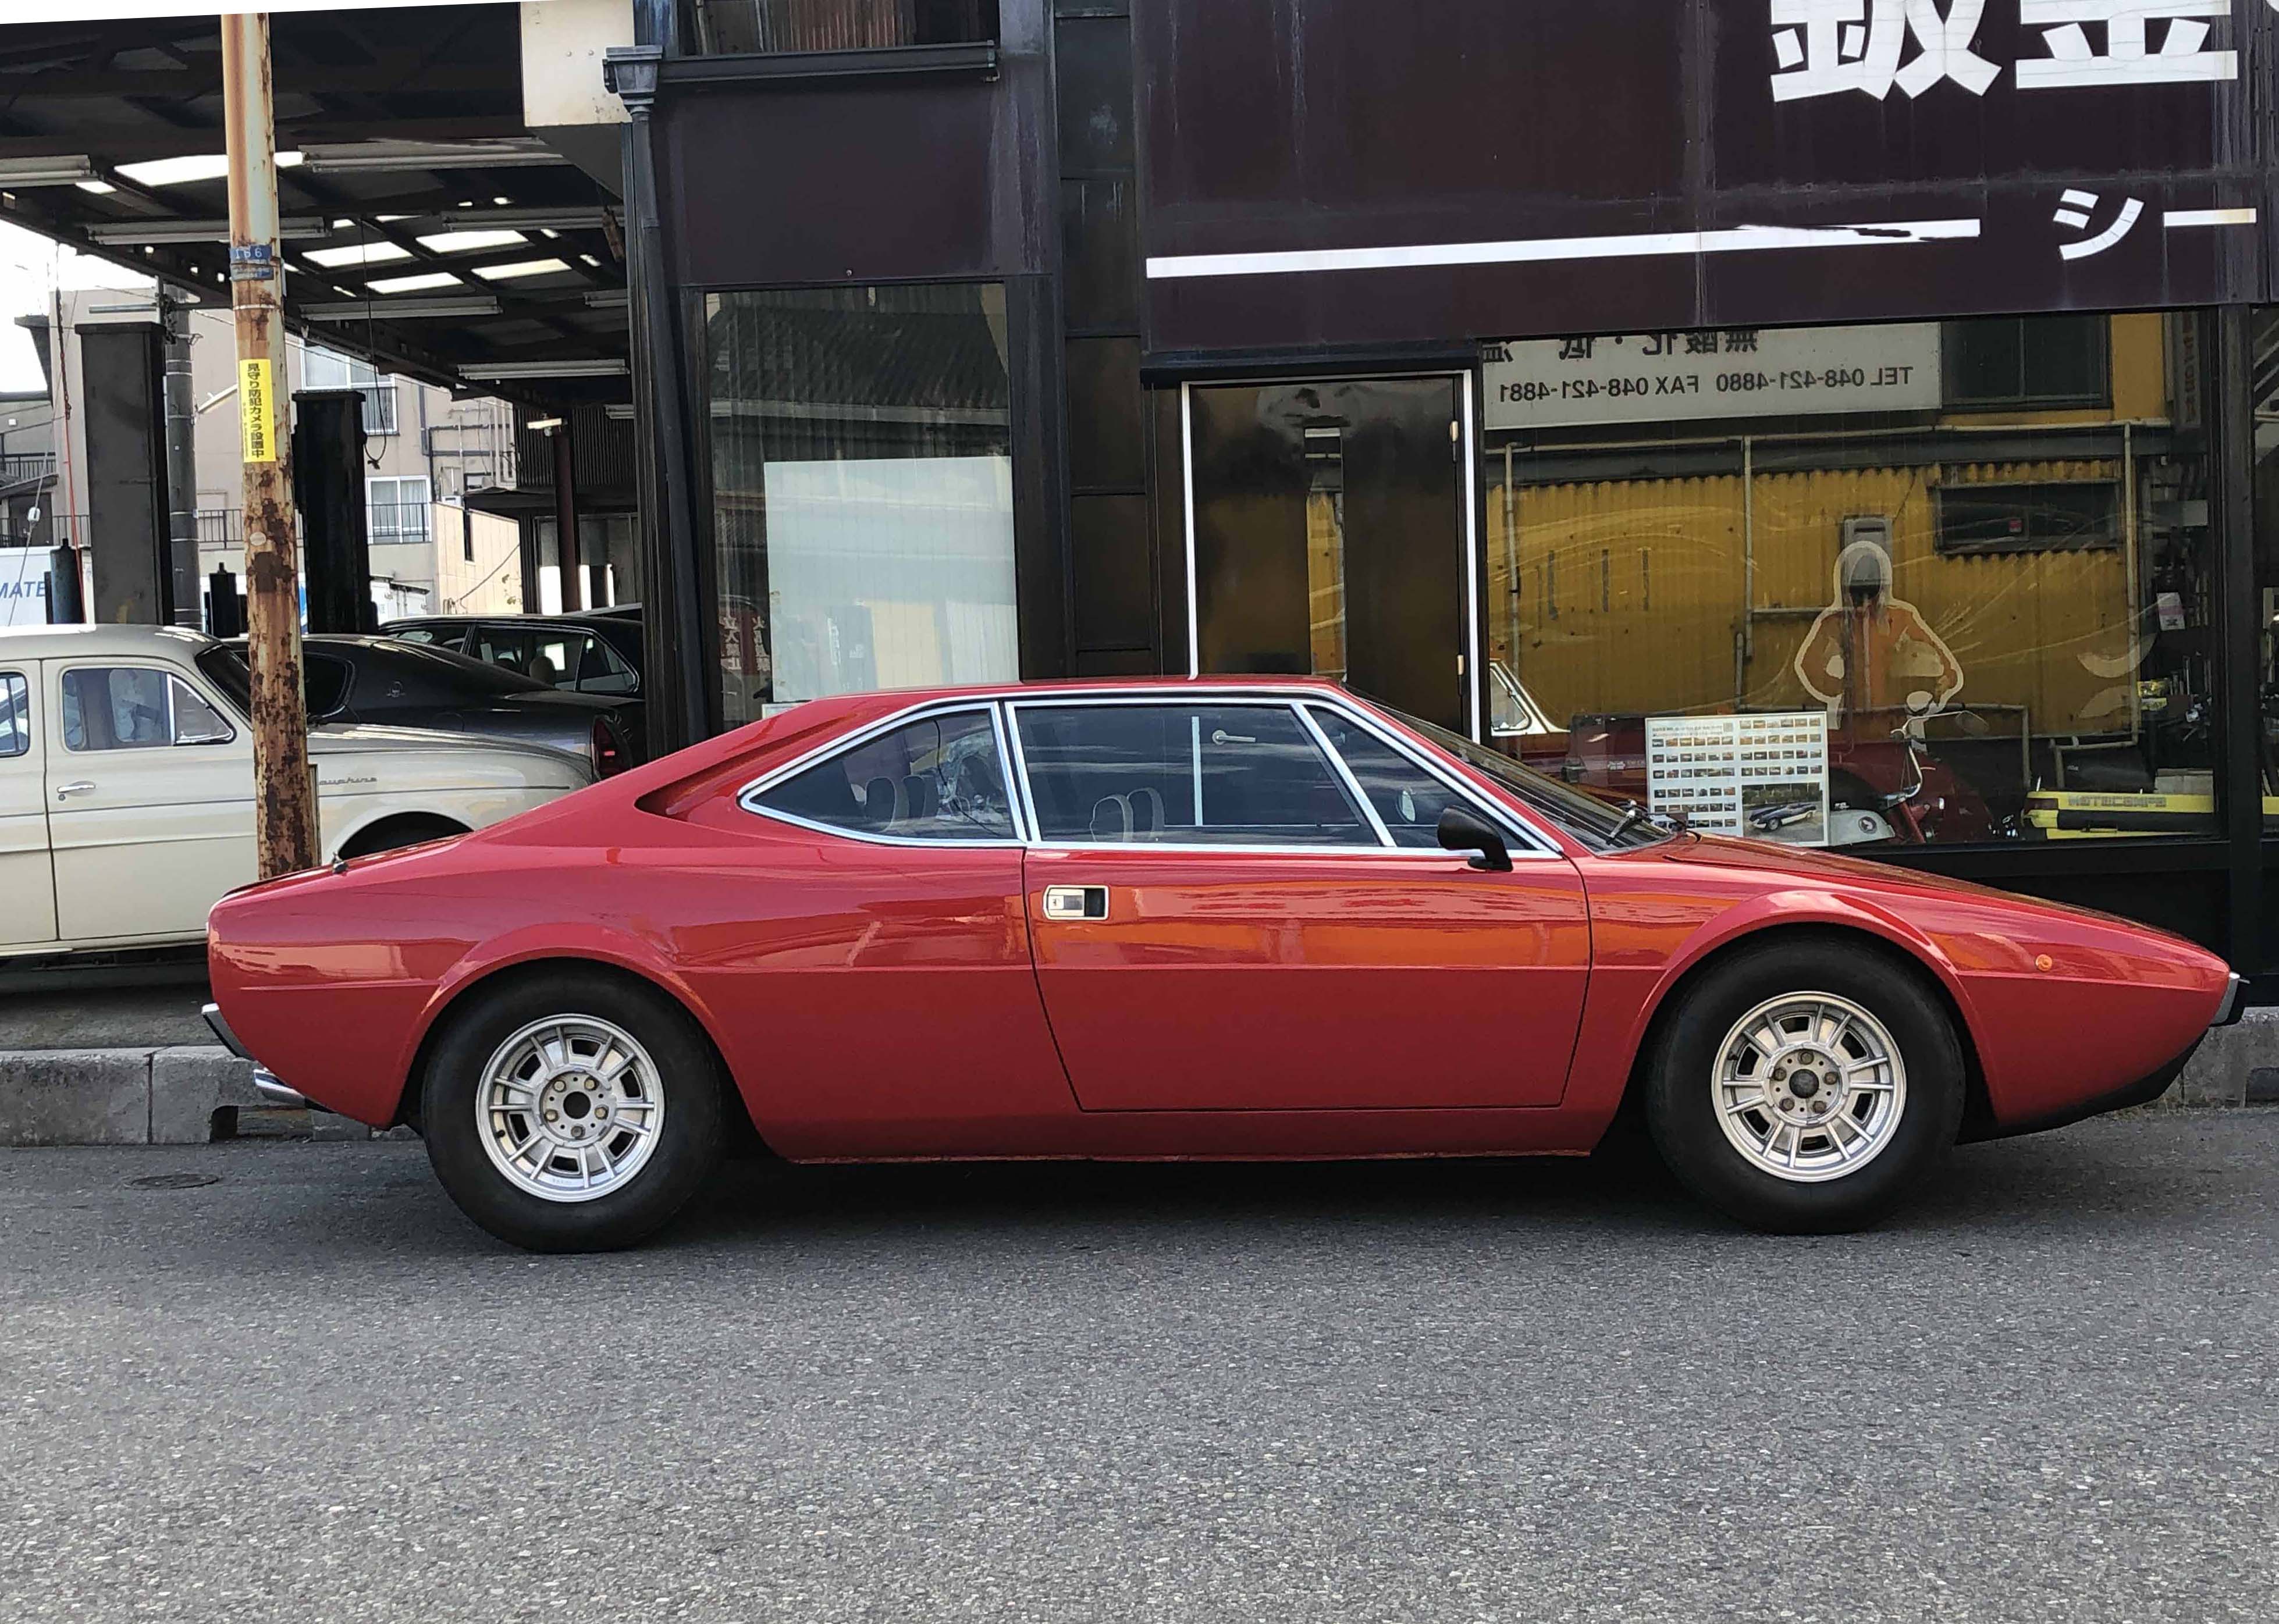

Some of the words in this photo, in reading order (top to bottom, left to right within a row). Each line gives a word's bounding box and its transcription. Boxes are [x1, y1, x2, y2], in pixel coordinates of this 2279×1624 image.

[248, 363, 264, 458] 見守り防犯カメラ設置中
